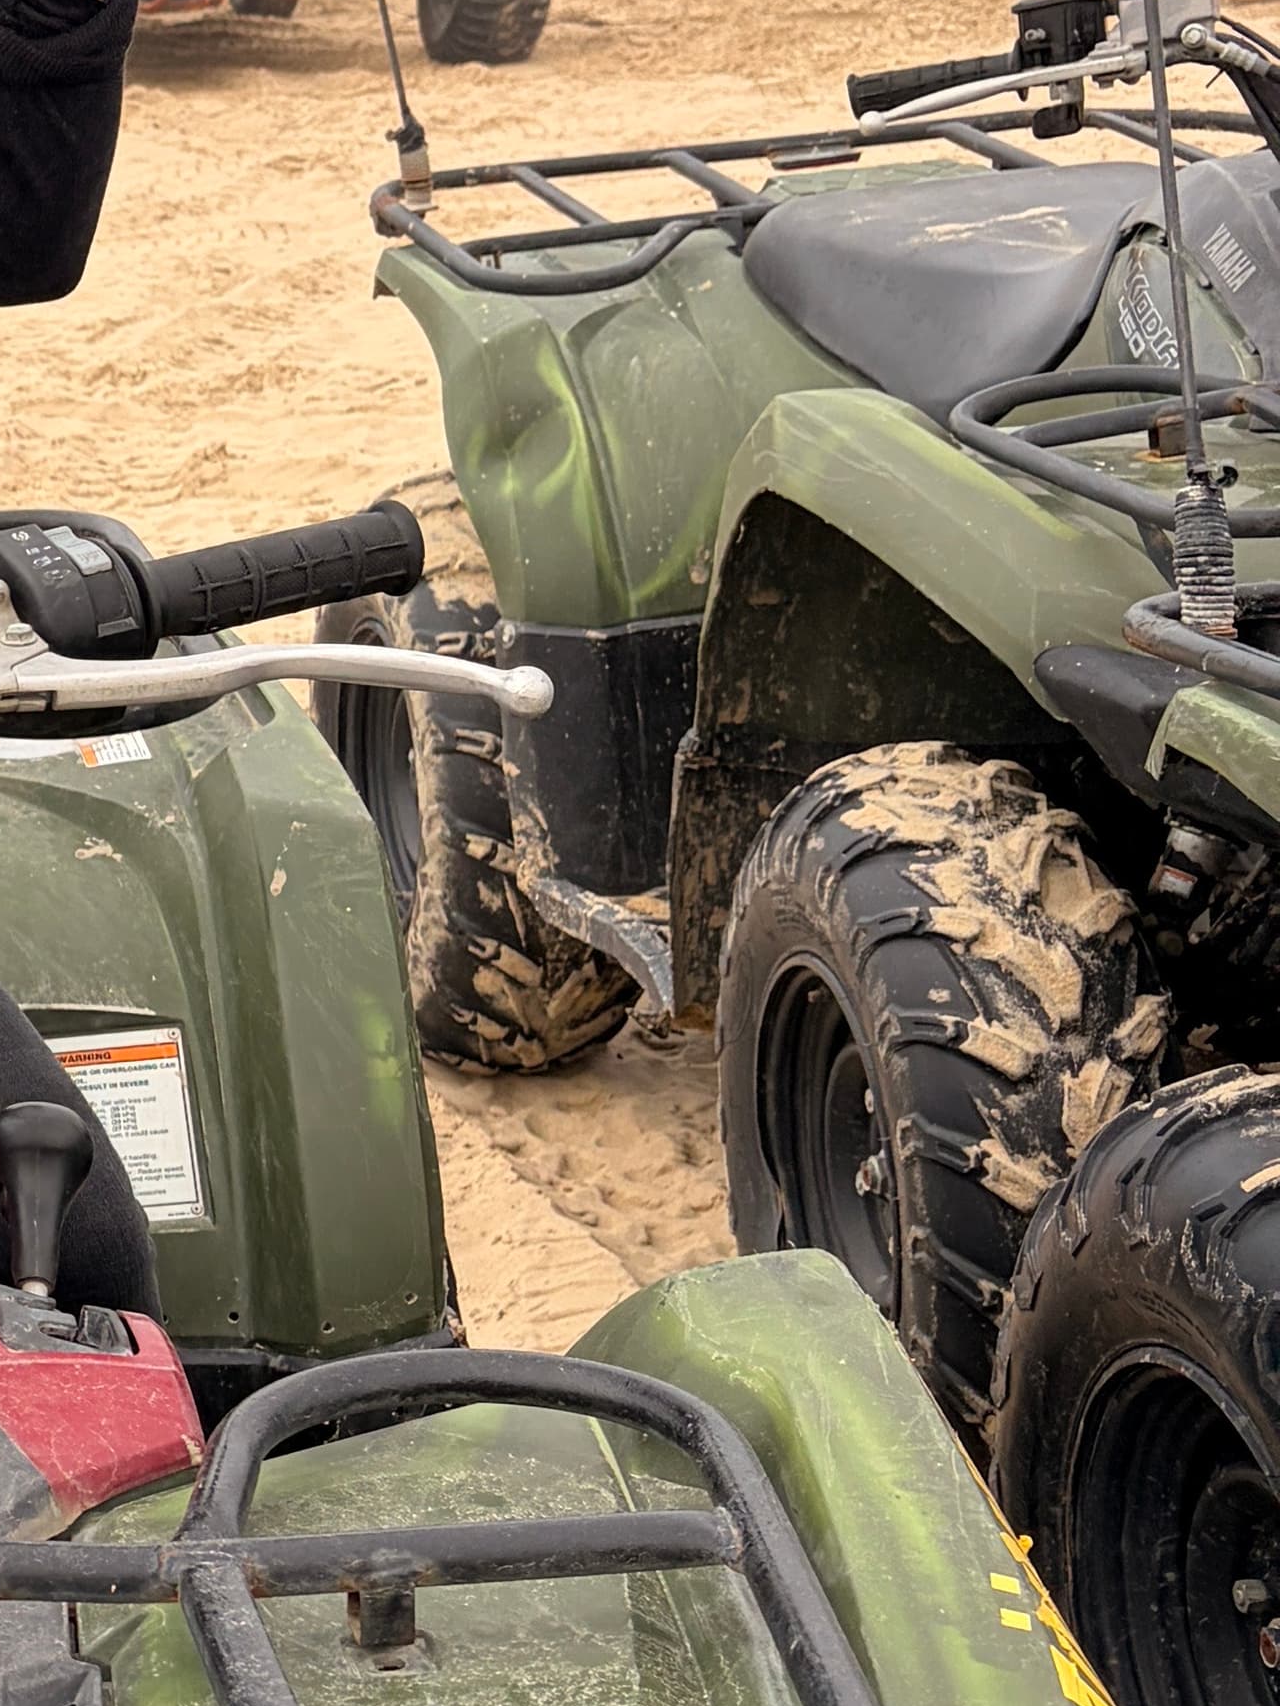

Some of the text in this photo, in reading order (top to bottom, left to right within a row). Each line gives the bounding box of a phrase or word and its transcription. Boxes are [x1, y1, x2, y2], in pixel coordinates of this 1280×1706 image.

[1202, 221, 1257, 293] YAMAHA
[1118, 295, 1146, 359] 450
[1123, 258, 1181, 370] KODIA
